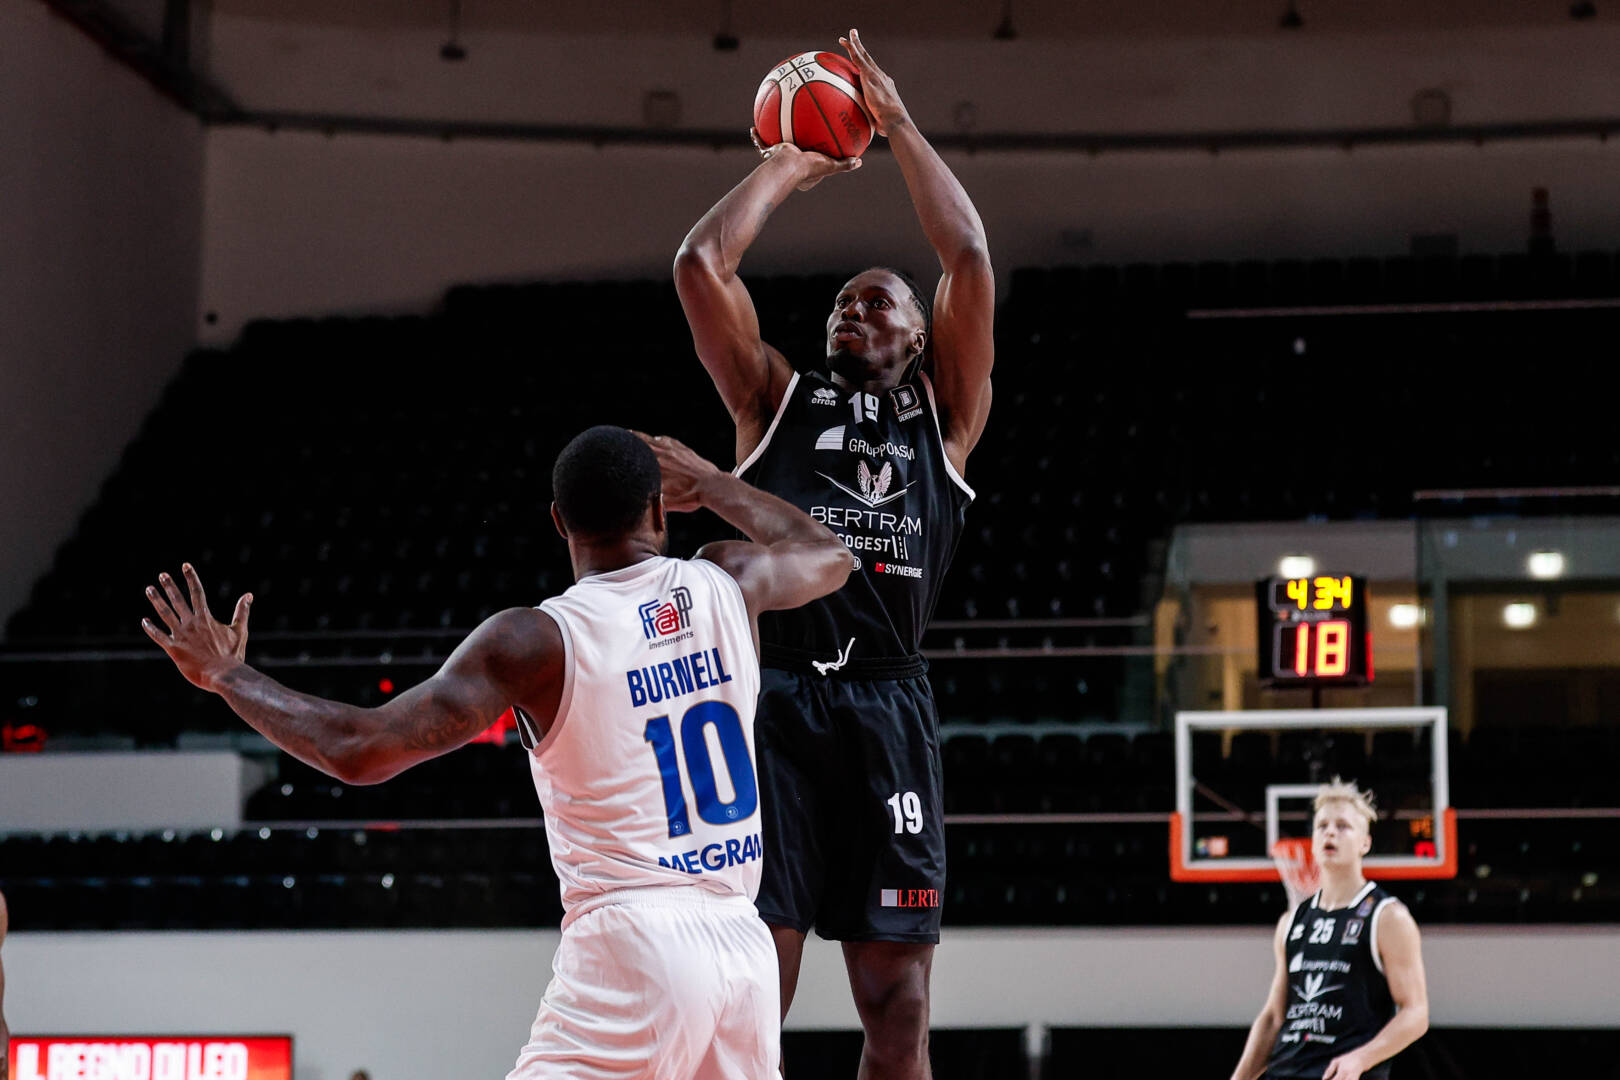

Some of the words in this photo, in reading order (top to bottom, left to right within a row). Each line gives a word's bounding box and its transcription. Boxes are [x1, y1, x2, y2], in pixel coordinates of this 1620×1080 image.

[848, 392, 880, 424] 19
[810, 506, 922, 536] BERTRAM
[884, 563, 923, 579] SYNERGIE
[1294, 621, 1349, 677] 18
[626, 647, 732, 708] BURNELL
[643, 700, 758, 840] 10
[887, 791, 924, 834] 19
[1308, 918, 1336, 944] 25
